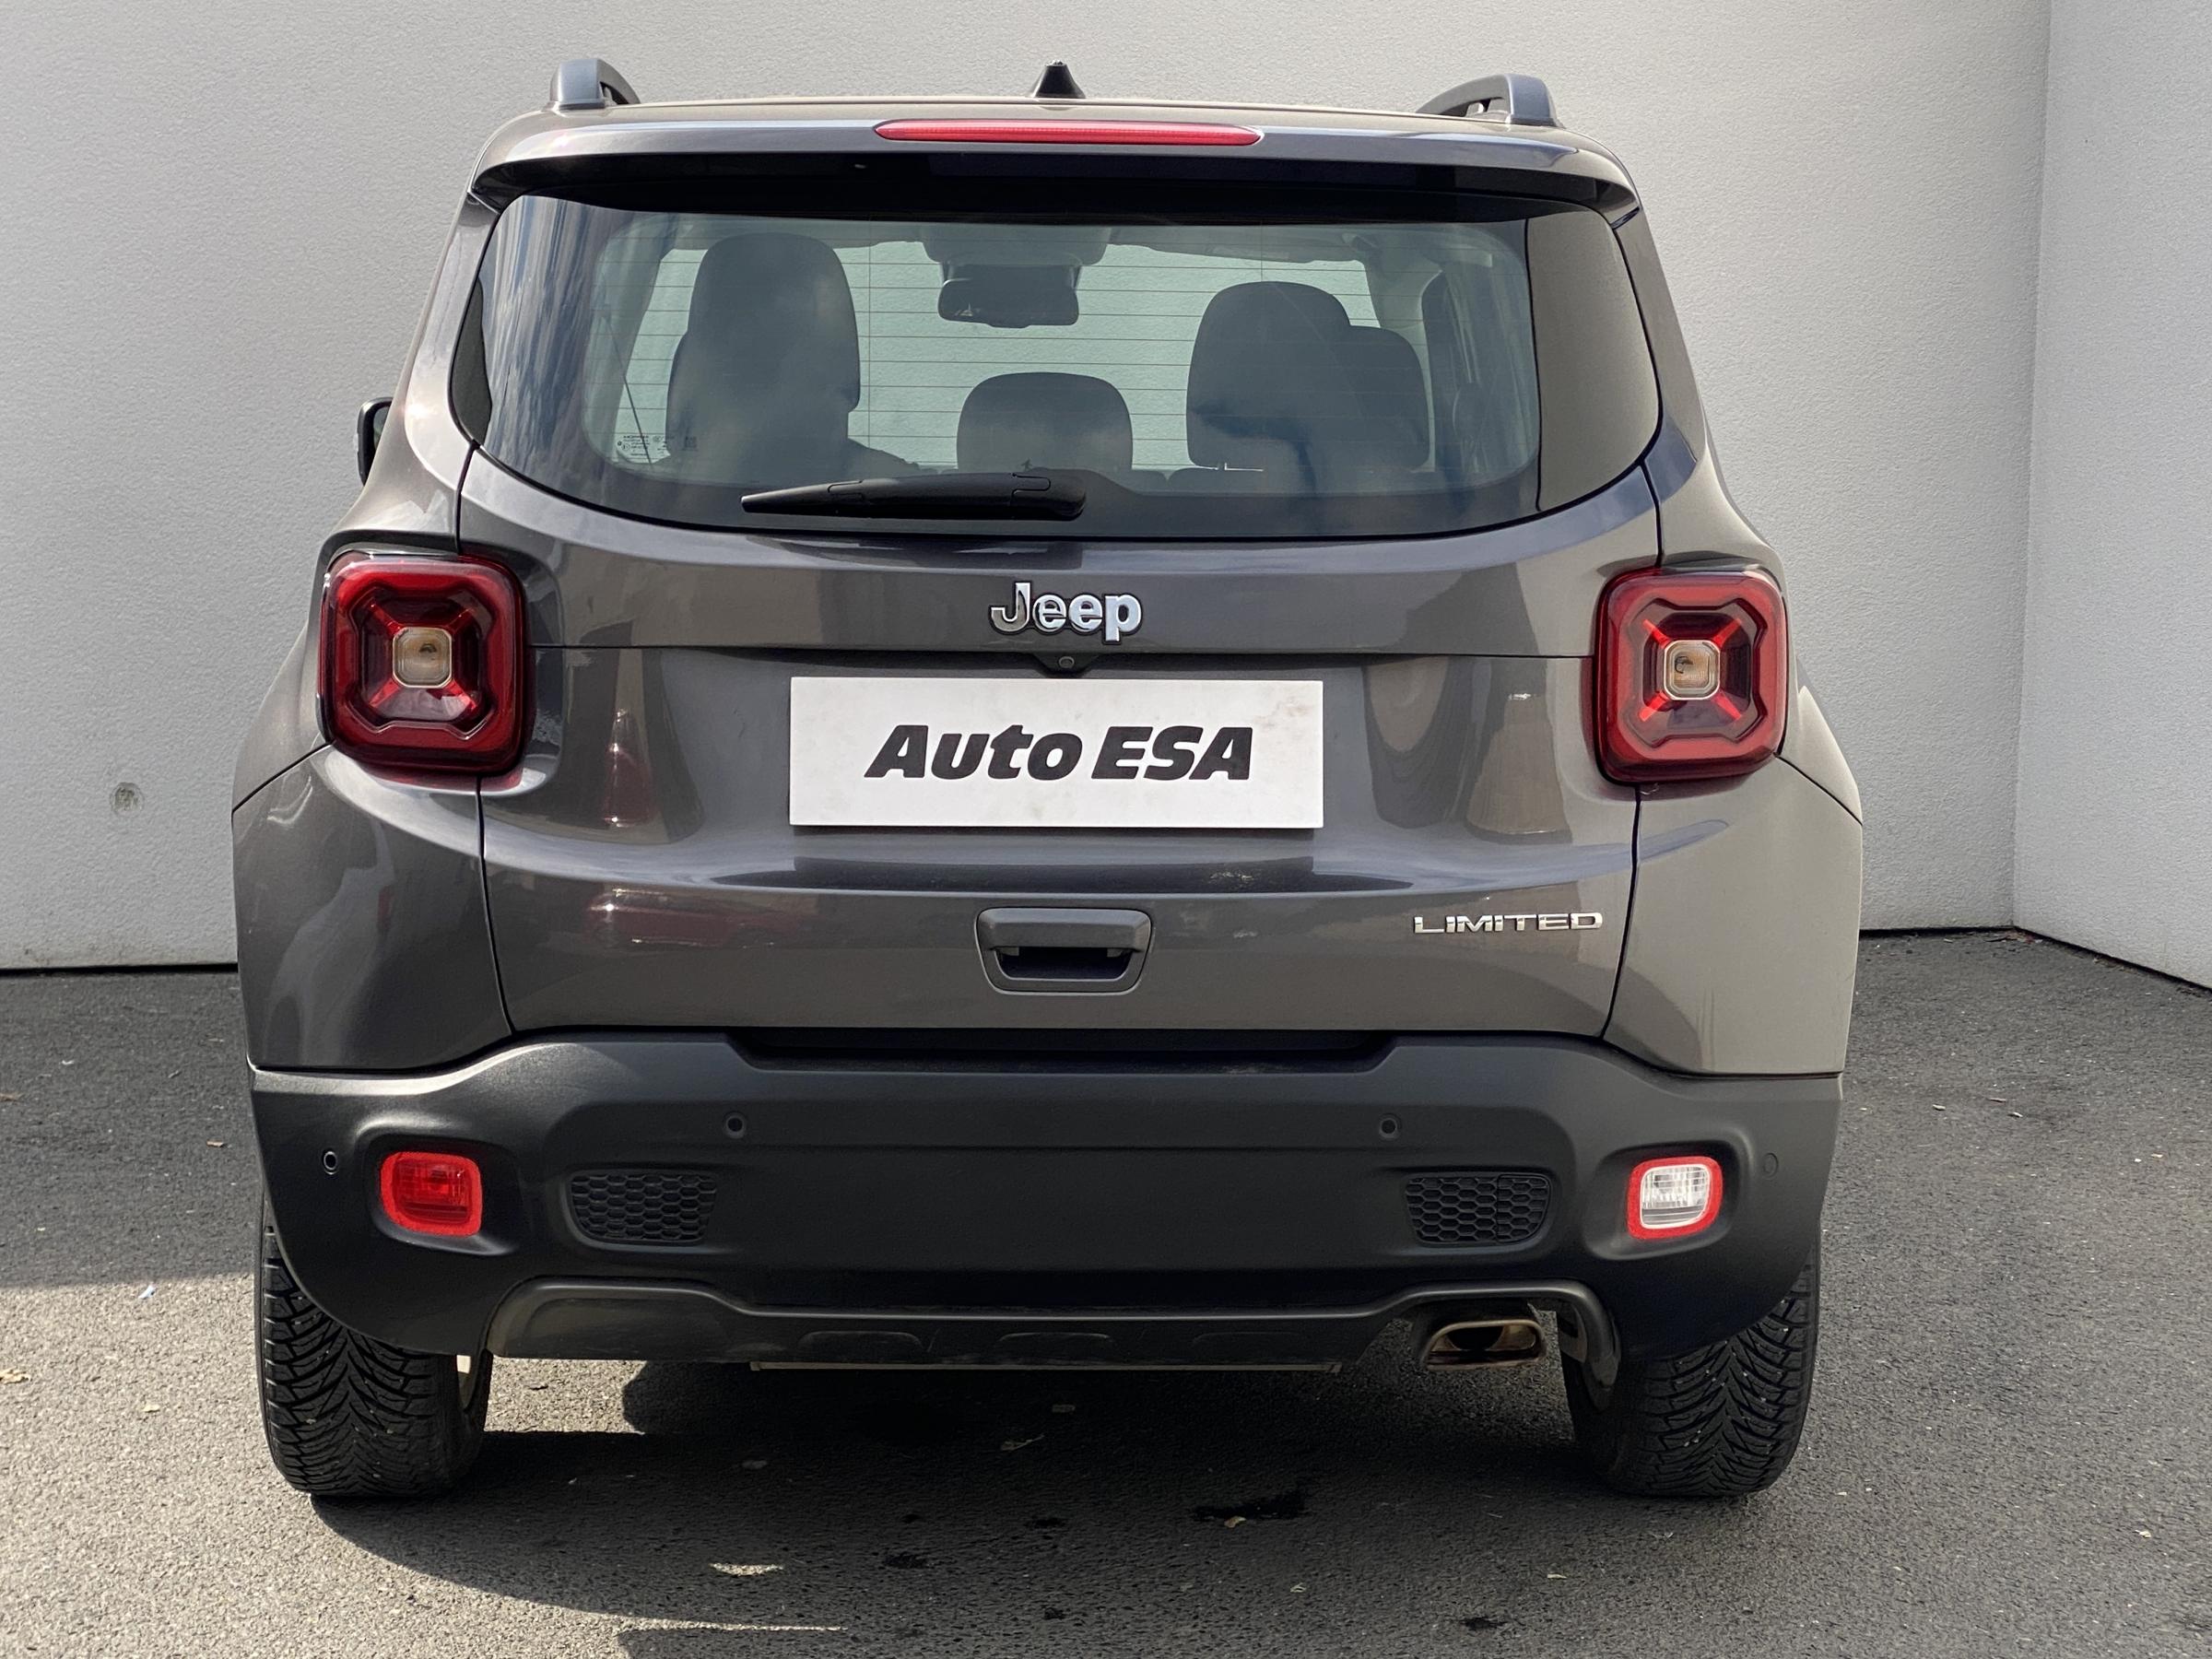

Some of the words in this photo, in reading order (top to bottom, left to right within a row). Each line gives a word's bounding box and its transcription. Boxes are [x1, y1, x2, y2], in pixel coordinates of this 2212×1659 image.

[990, 582, 1143, 642] Jeep
[864, 724, 1083, 781] Auto
[1090, 725, 1253, 781] ESA
[1414, 912, 1604, 934] LIMITED
